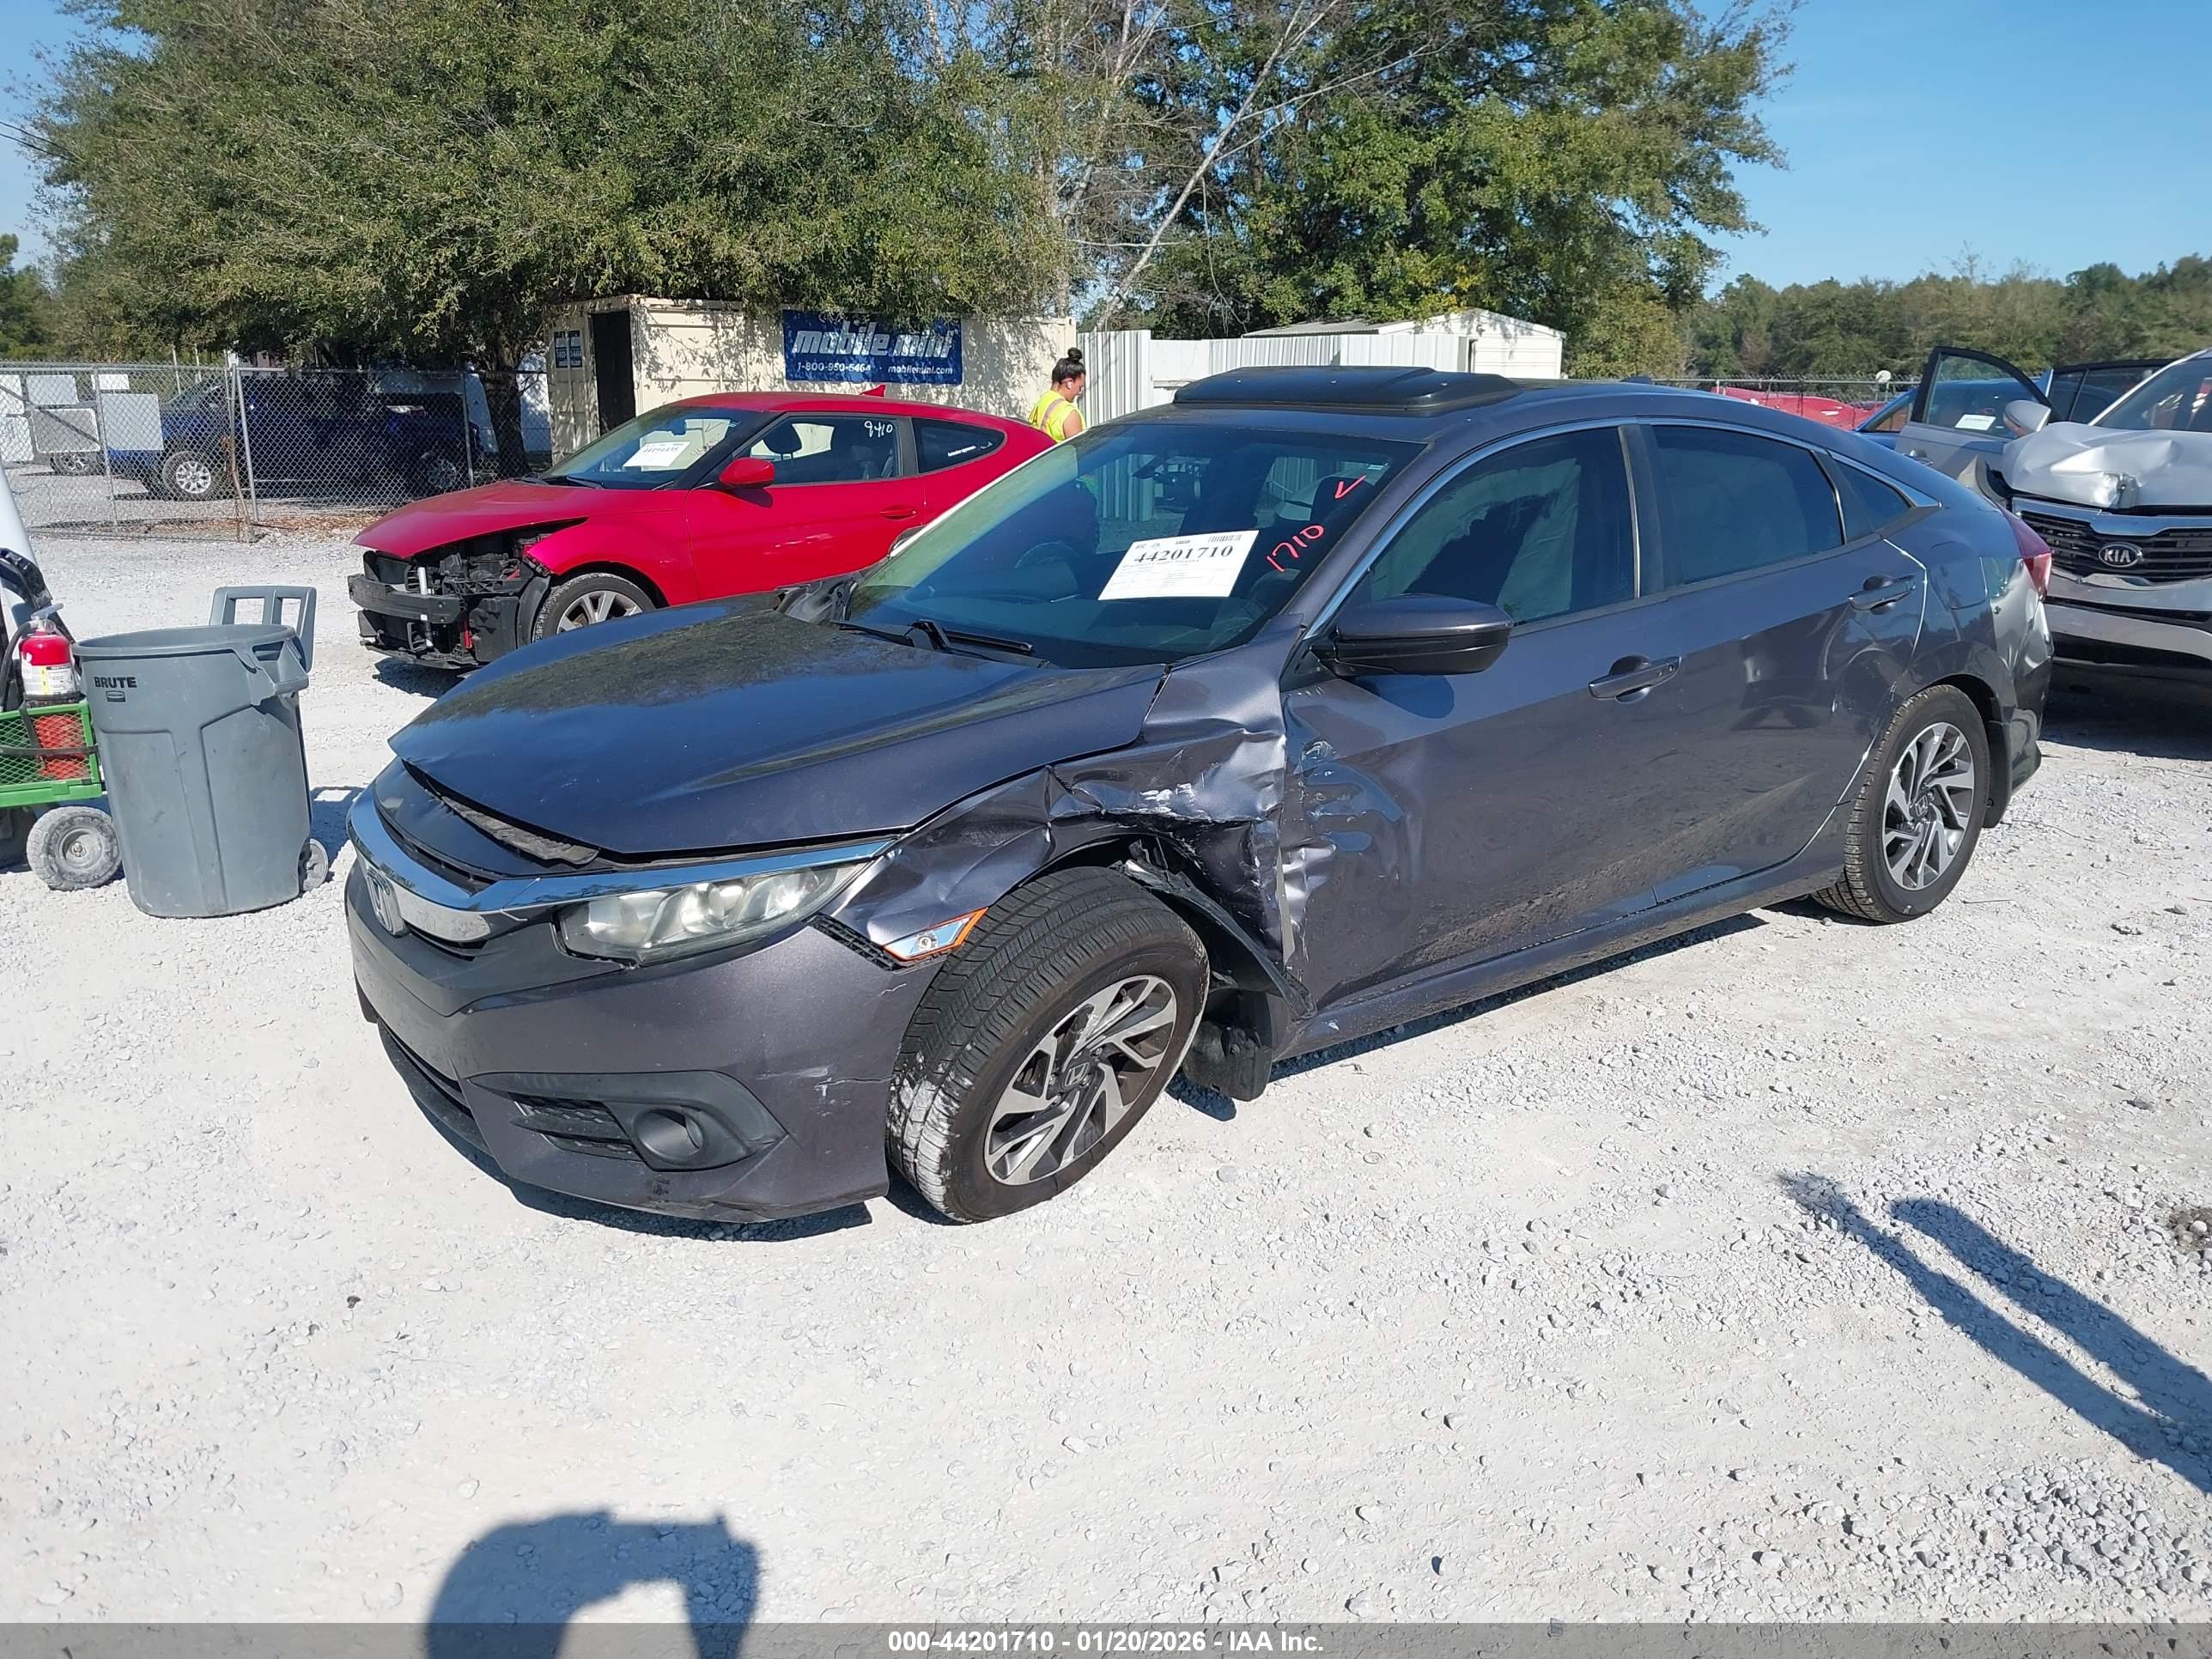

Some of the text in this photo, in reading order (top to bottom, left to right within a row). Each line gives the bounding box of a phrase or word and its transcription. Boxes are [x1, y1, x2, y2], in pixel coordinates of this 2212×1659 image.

[792, 320, 955, 357] mobile mini
[888, 365, 953, 374] mobilemini.com
[864, 420, 894, 437] 9410
[1133, 545, 1233, 563] 44201710
[1267, 524, 1324, 572] 1710
[2105, 549, 2130, 562] KIA
[94, 677, 137, 689] BRUTE
